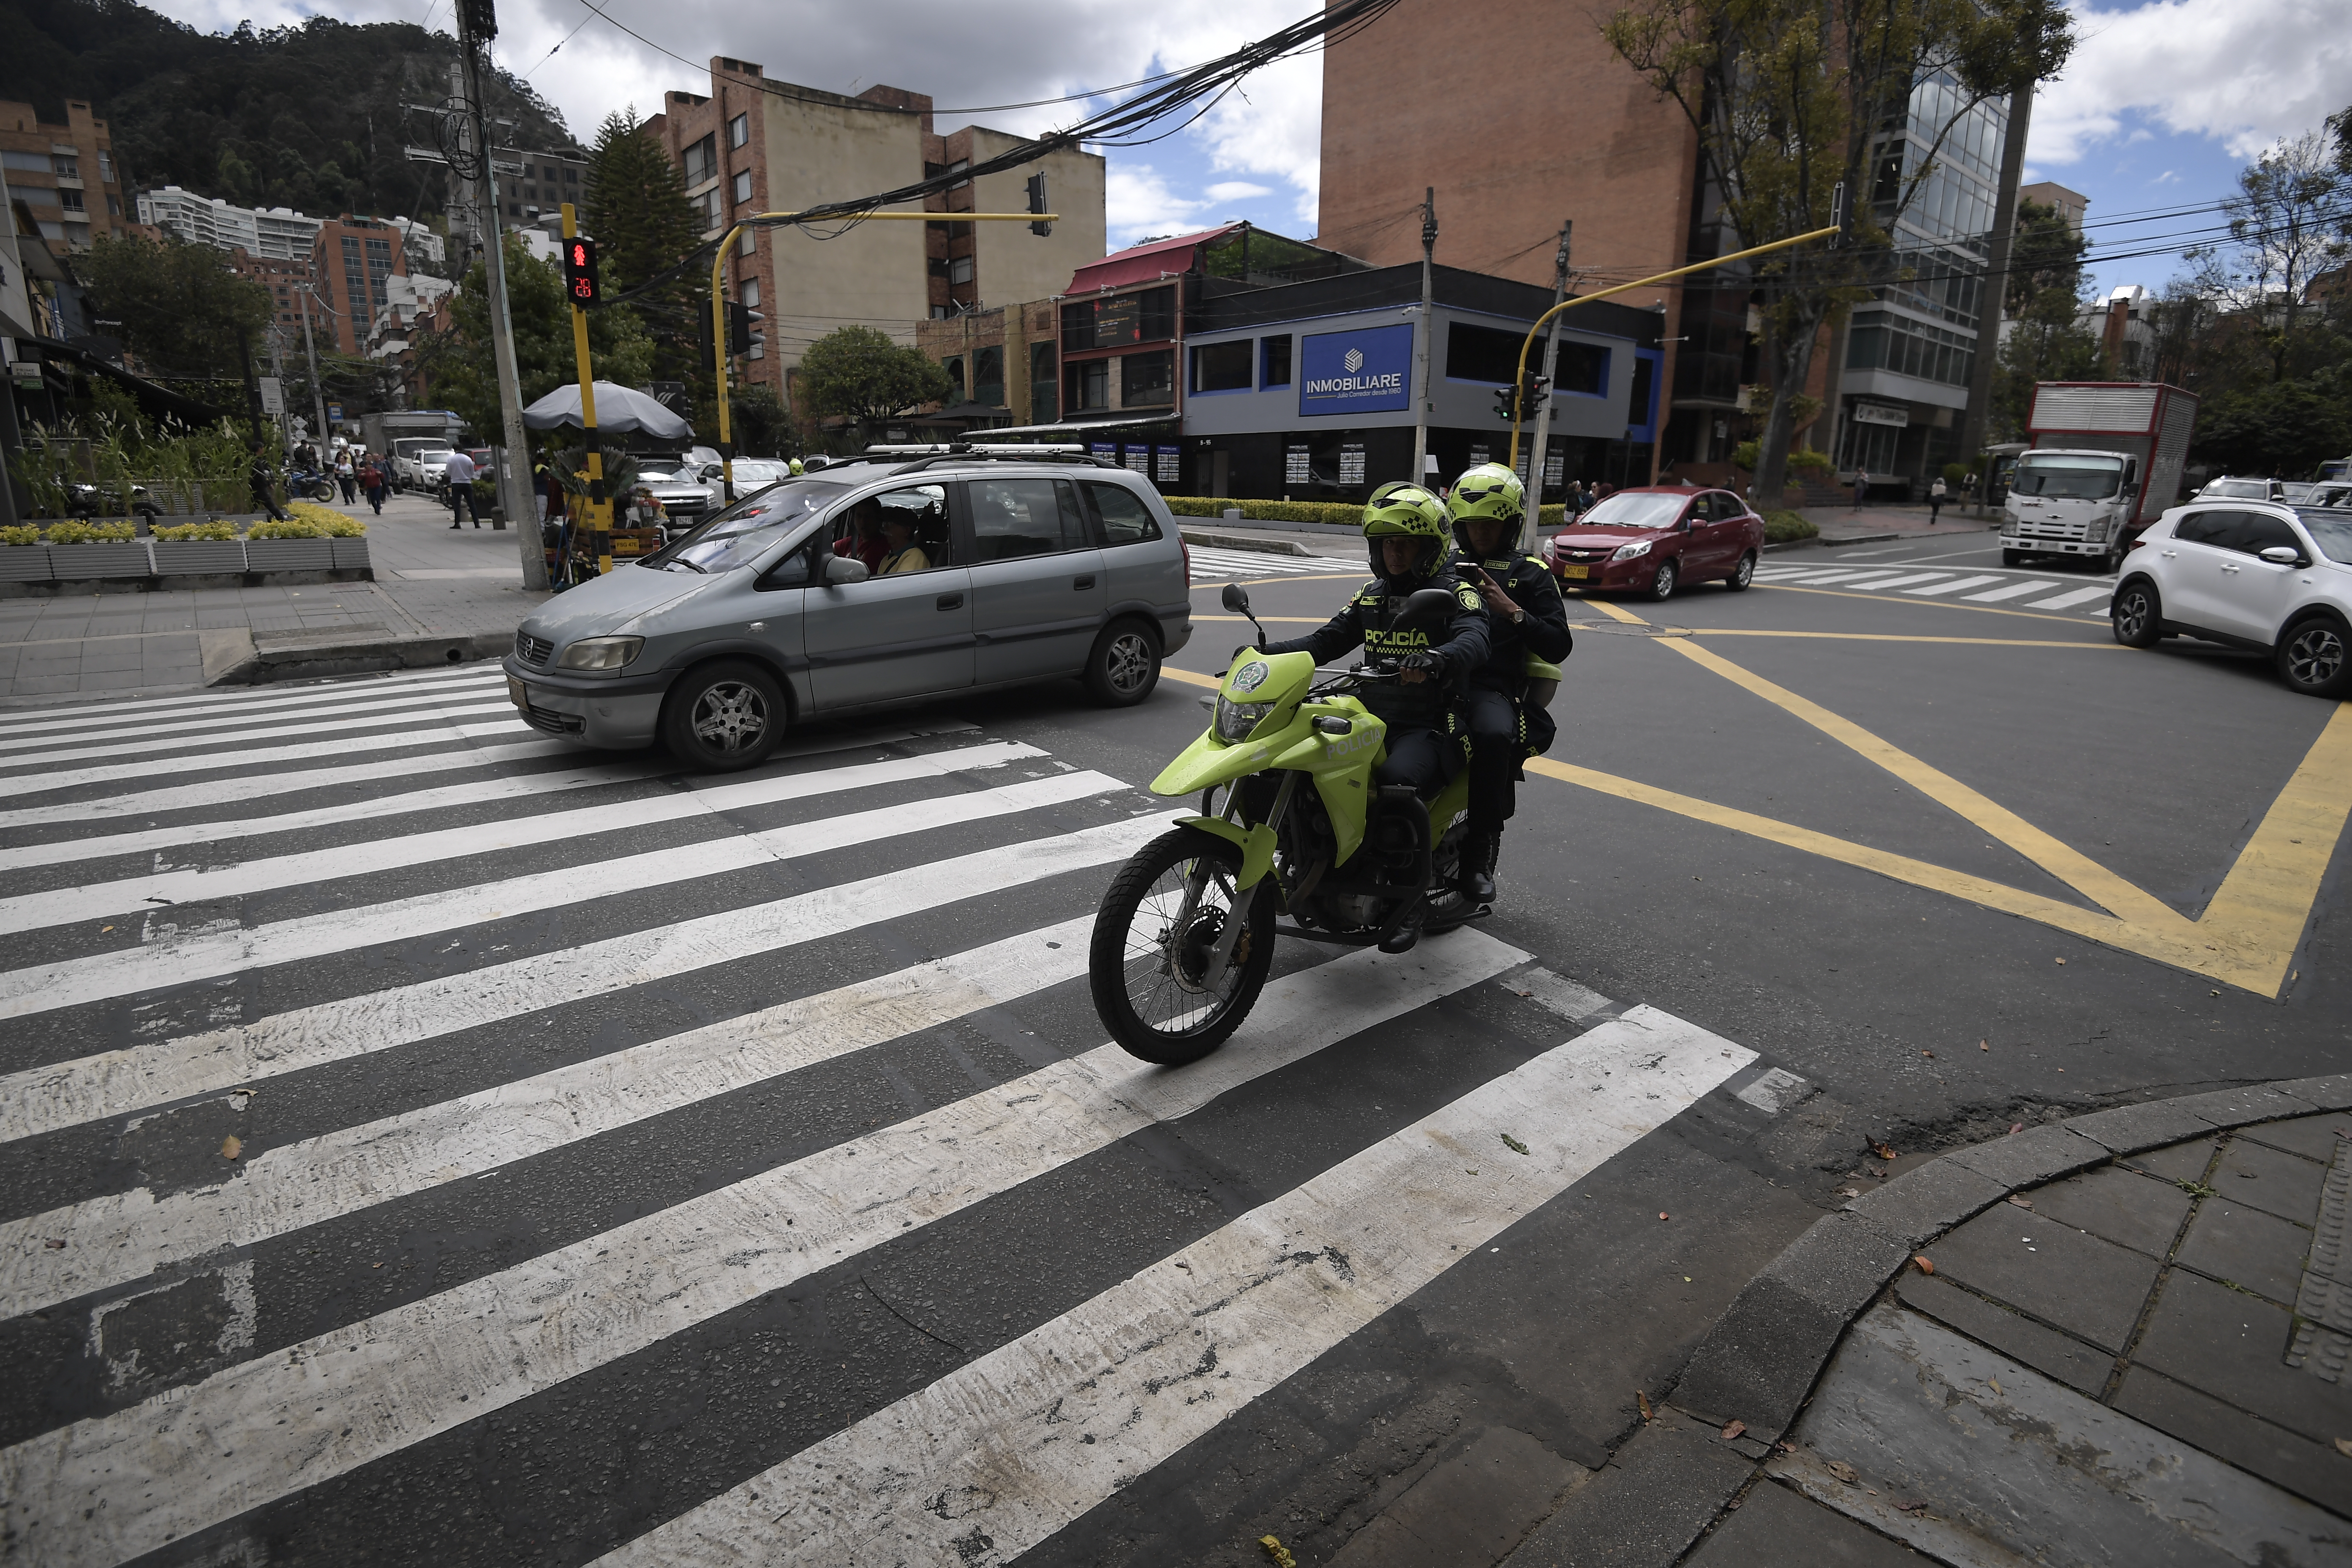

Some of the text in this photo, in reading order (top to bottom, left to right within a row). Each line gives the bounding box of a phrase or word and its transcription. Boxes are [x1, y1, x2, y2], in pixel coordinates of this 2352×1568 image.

[575, 277, 591, 297] 28
[1307, 373, 1402, 393] INMOBILIARE
[1365, 627, 1429, 646] POLICÍA
[1326, 727, 1382, 760] POLICIA
